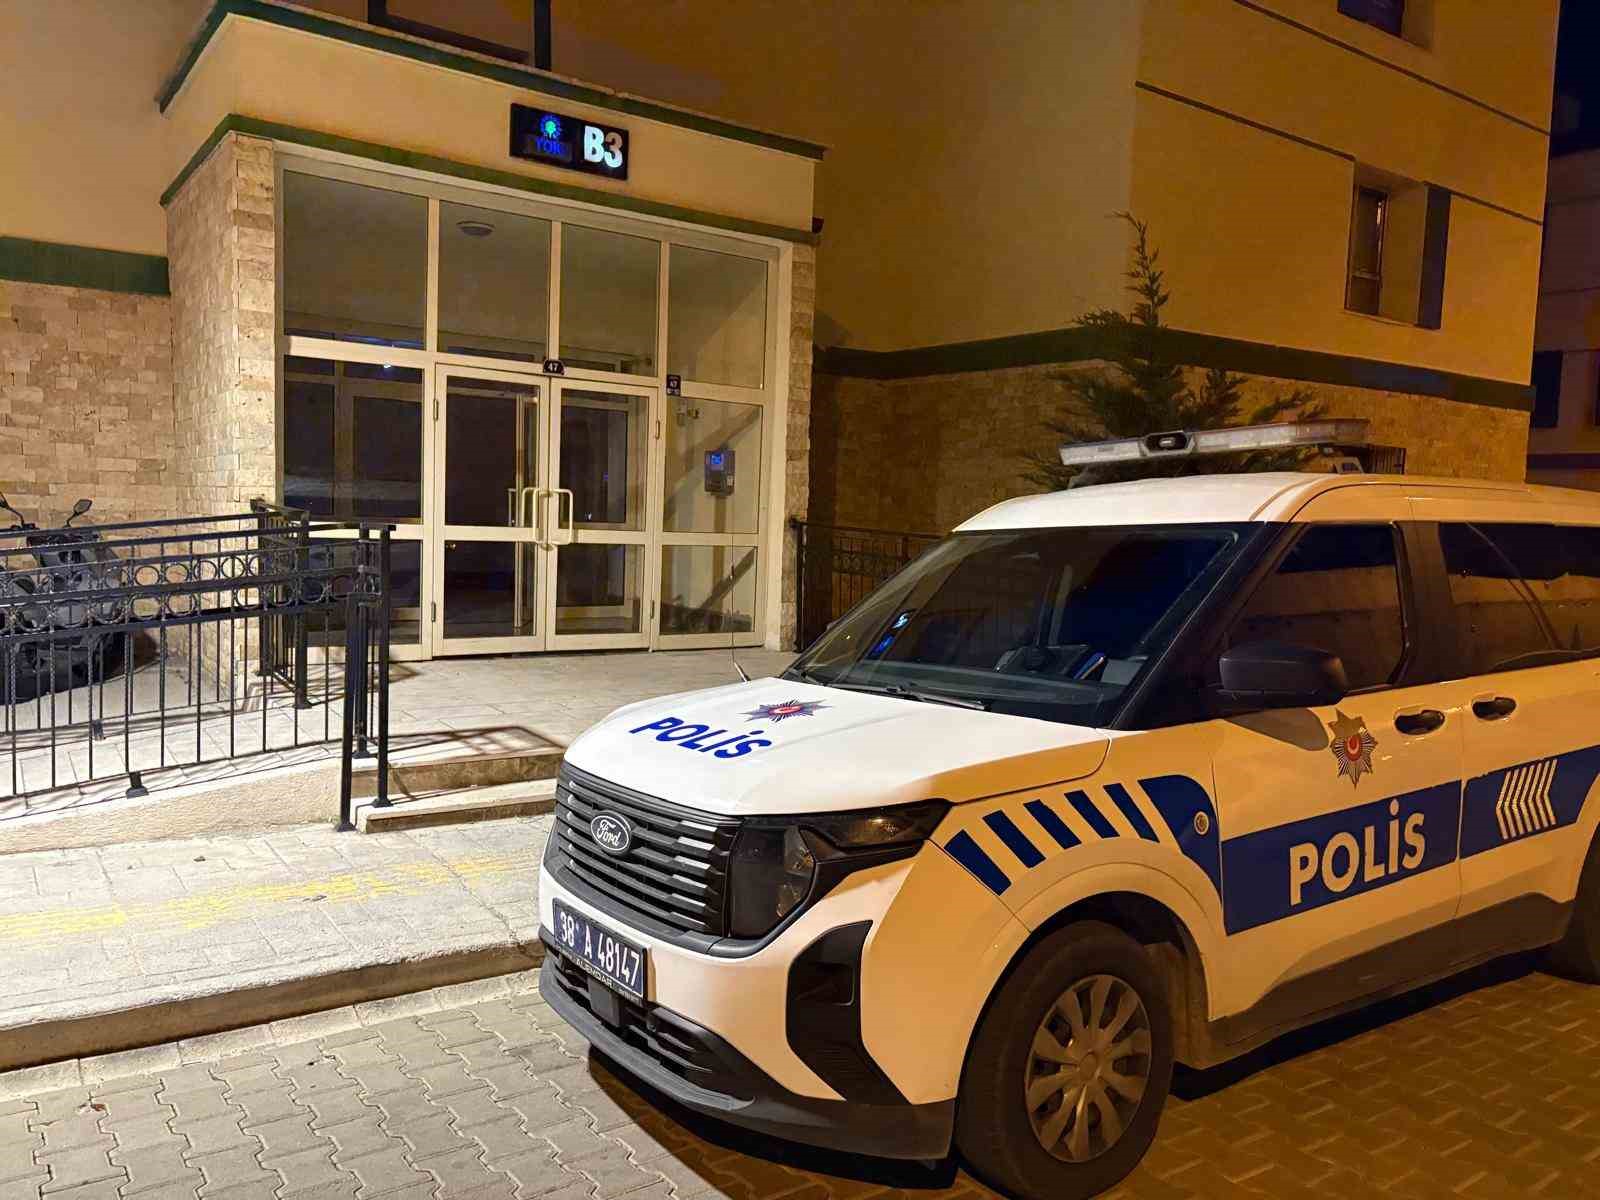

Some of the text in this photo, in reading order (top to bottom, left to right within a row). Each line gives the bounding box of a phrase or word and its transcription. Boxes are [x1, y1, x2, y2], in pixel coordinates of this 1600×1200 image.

[584, 125, 623, 168] B3
[547, 362, 559, 372] 47
[629, 716, 773, 759] POLİS
[597, 819, 621, 846] Ford
[1289, 799, 1426, 906] POLİS
[560, 911, 575, 947] 38
[584, 925, 593, 959] A
[598, 933, 640, 986] 48147
